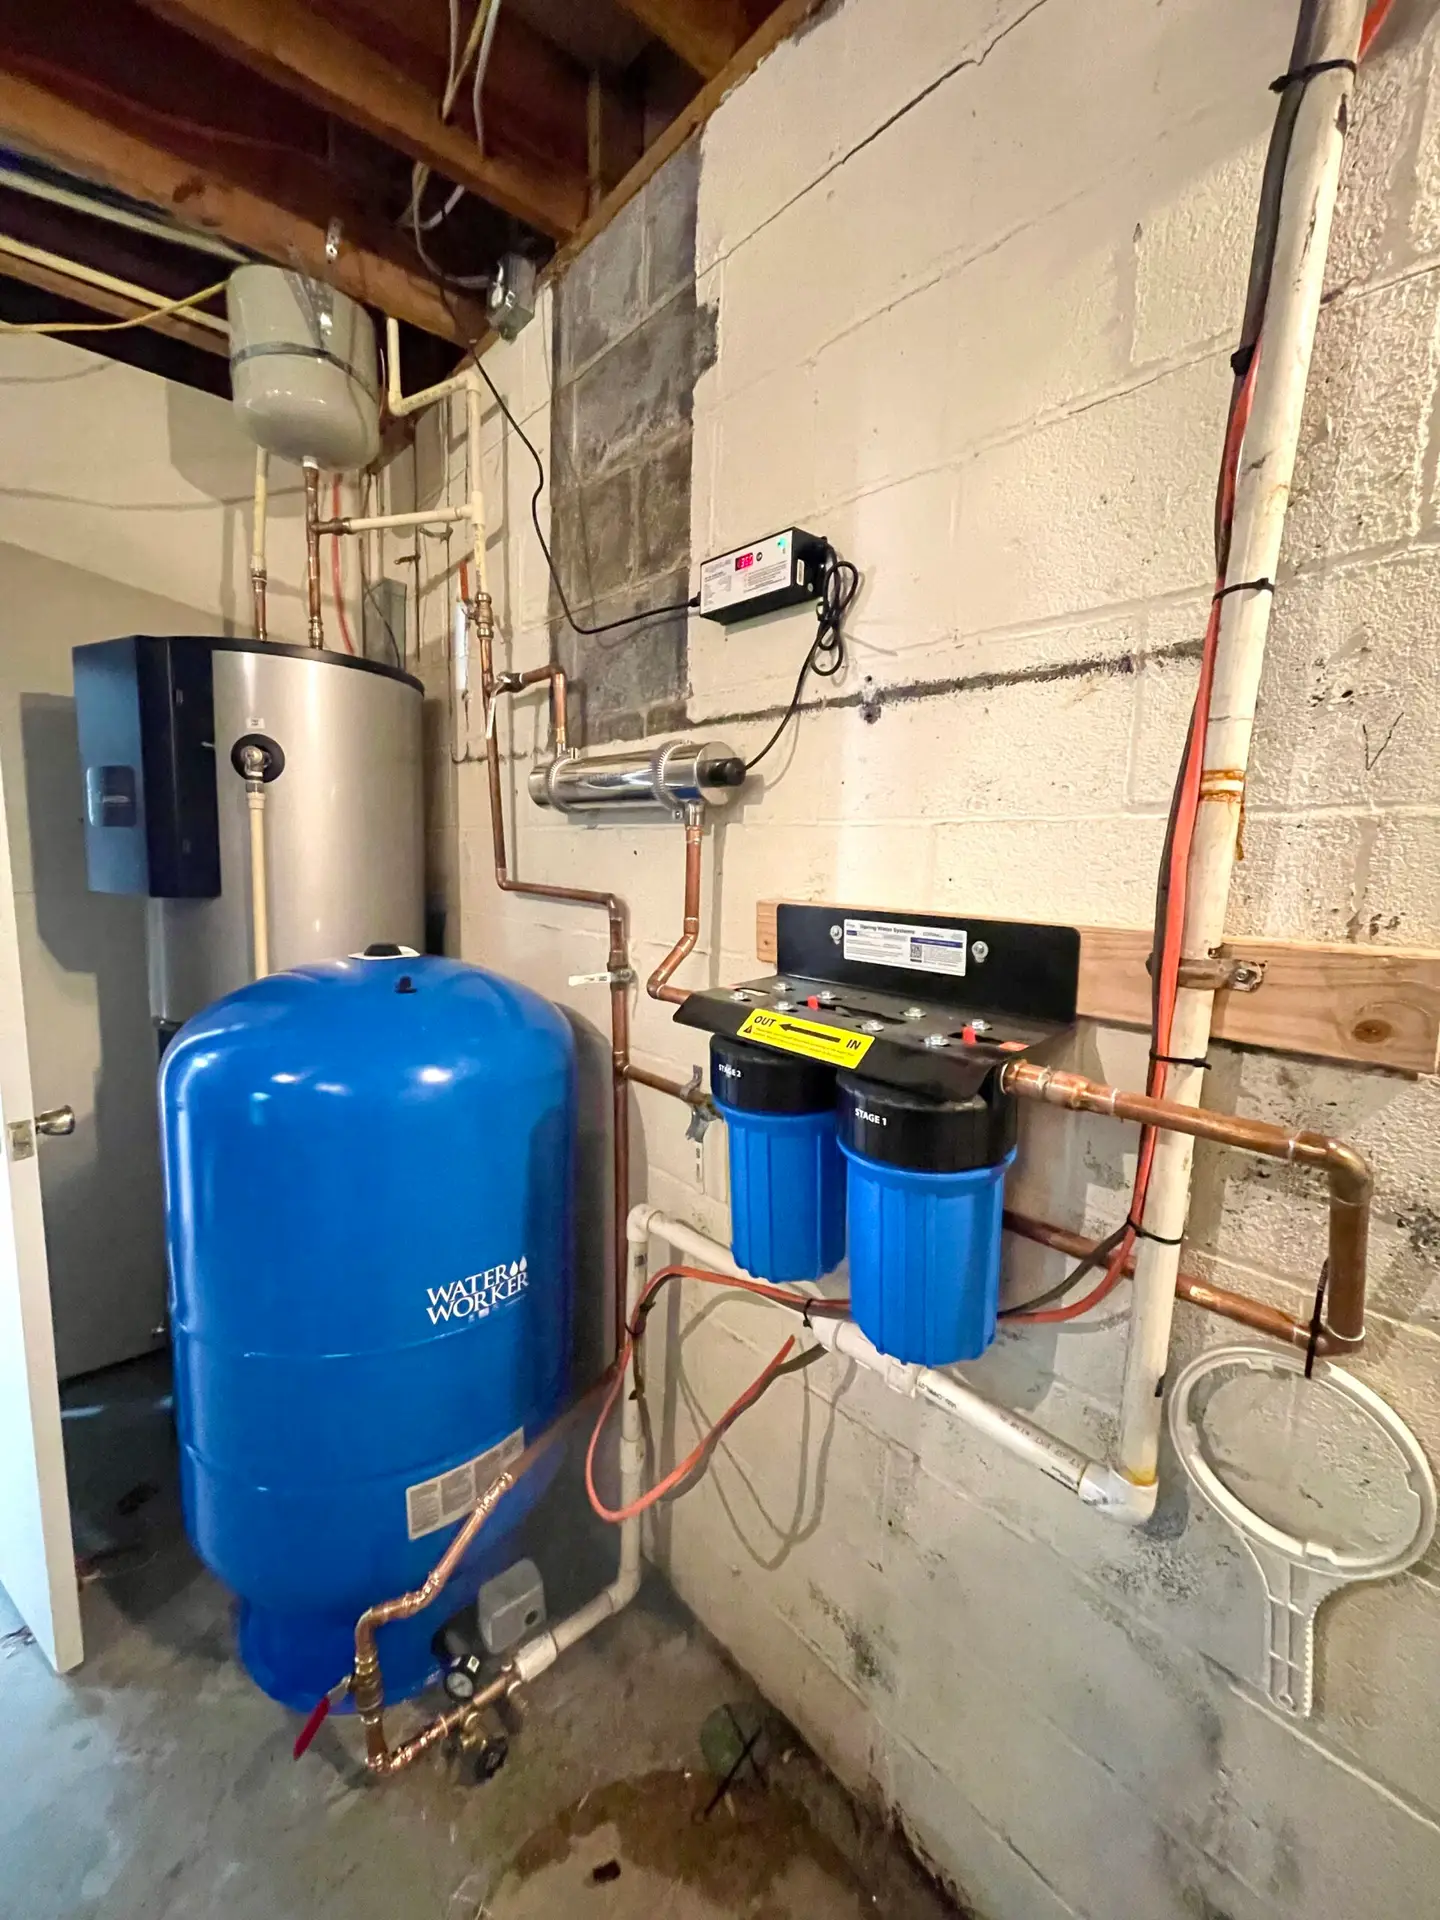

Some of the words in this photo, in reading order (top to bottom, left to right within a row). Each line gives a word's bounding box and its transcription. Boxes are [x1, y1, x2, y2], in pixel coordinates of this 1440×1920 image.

[753, 1015, 777, 1028] OUT
[846, 1039, 862, 1050] IN
[718, 1064, 736, 1077] STAGE
[736, 1070, 742, 1078] 2
[855, 1108, 881, 1124] STAGE
[881, 1116, 888, 1126] 1
[426, 1263, 509, 1306] WATER
[426, 1272, 530, 1325] WORKER
